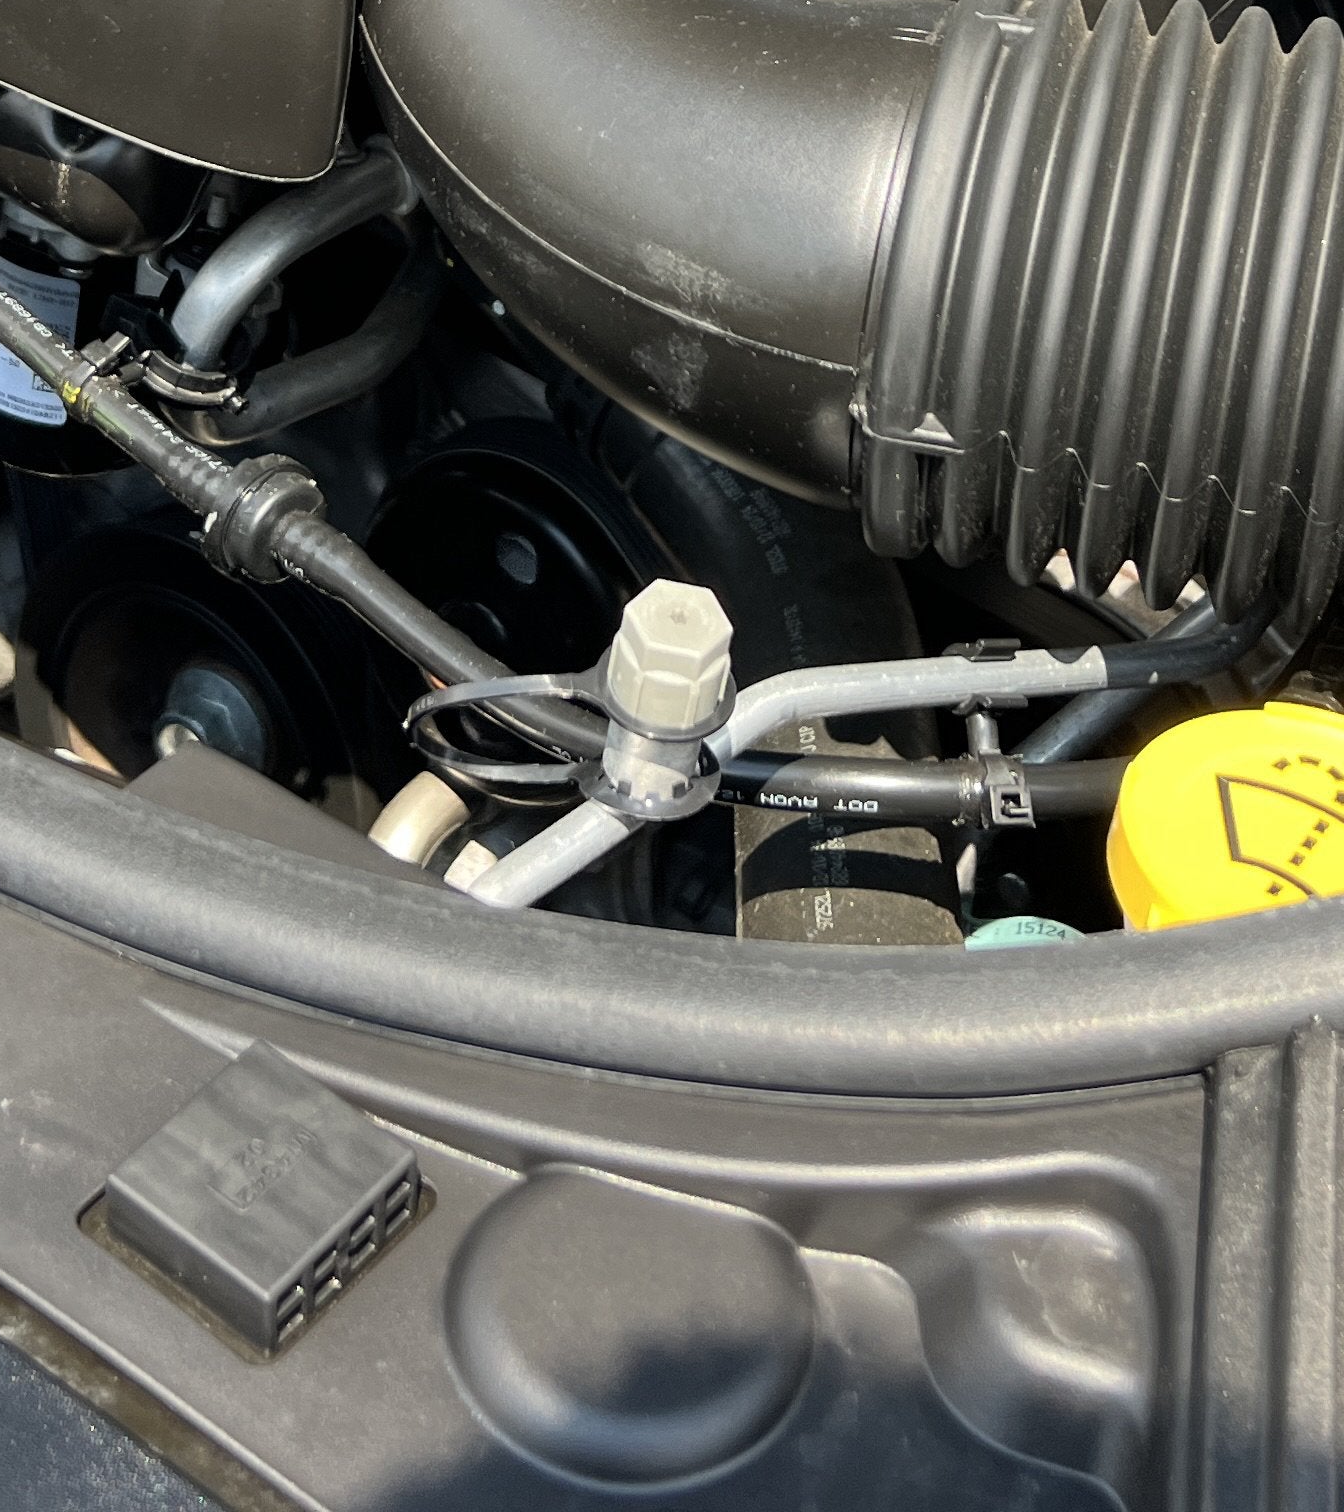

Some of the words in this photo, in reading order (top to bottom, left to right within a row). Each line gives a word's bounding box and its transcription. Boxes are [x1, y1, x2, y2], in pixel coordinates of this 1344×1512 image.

[760, 792, 818, 809] AVON
[834, 799, 879, 813] DOT
[1015, 921, 1066, 939] 15124
